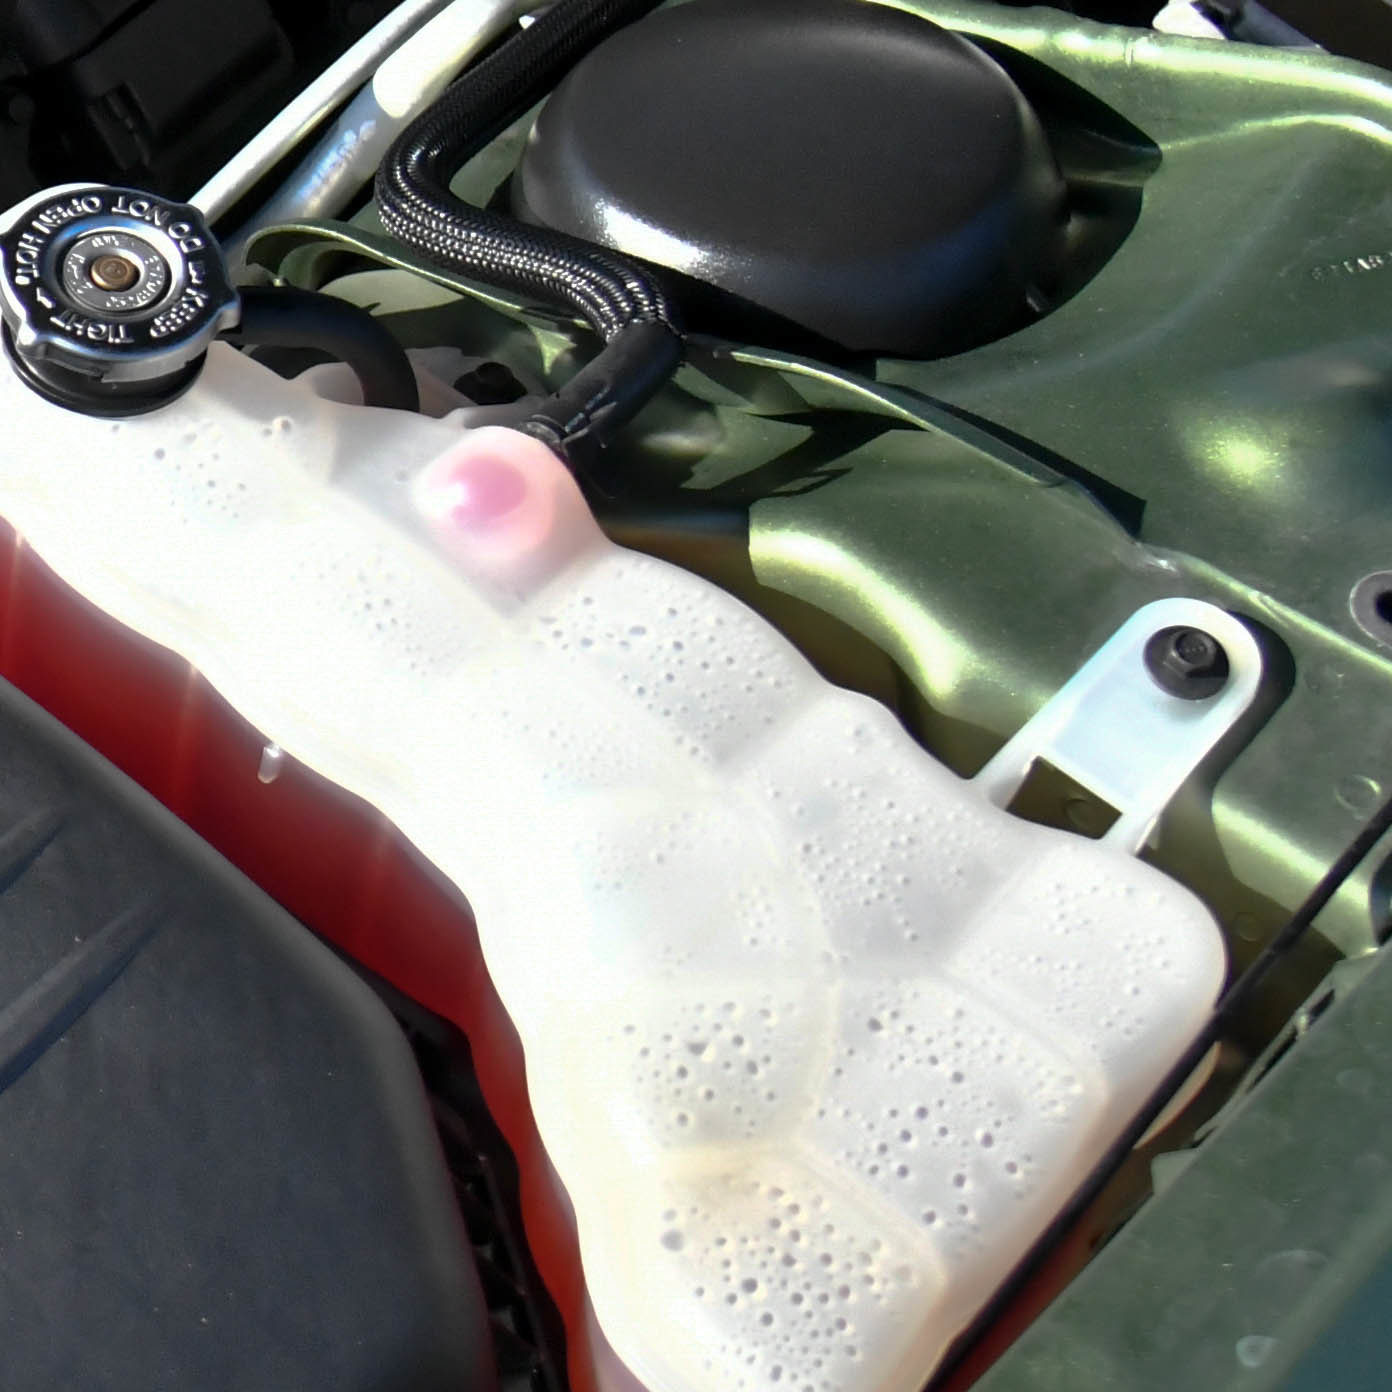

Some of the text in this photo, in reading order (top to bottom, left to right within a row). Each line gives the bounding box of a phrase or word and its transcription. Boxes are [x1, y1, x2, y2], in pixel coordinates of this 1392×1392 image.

[32, 195, 101, 233] OPEN
[111, 195, 170, 225] NOT
[168, 223, 205, 253] DO
[50, 287, 208, 343] KEEP TIGHT
